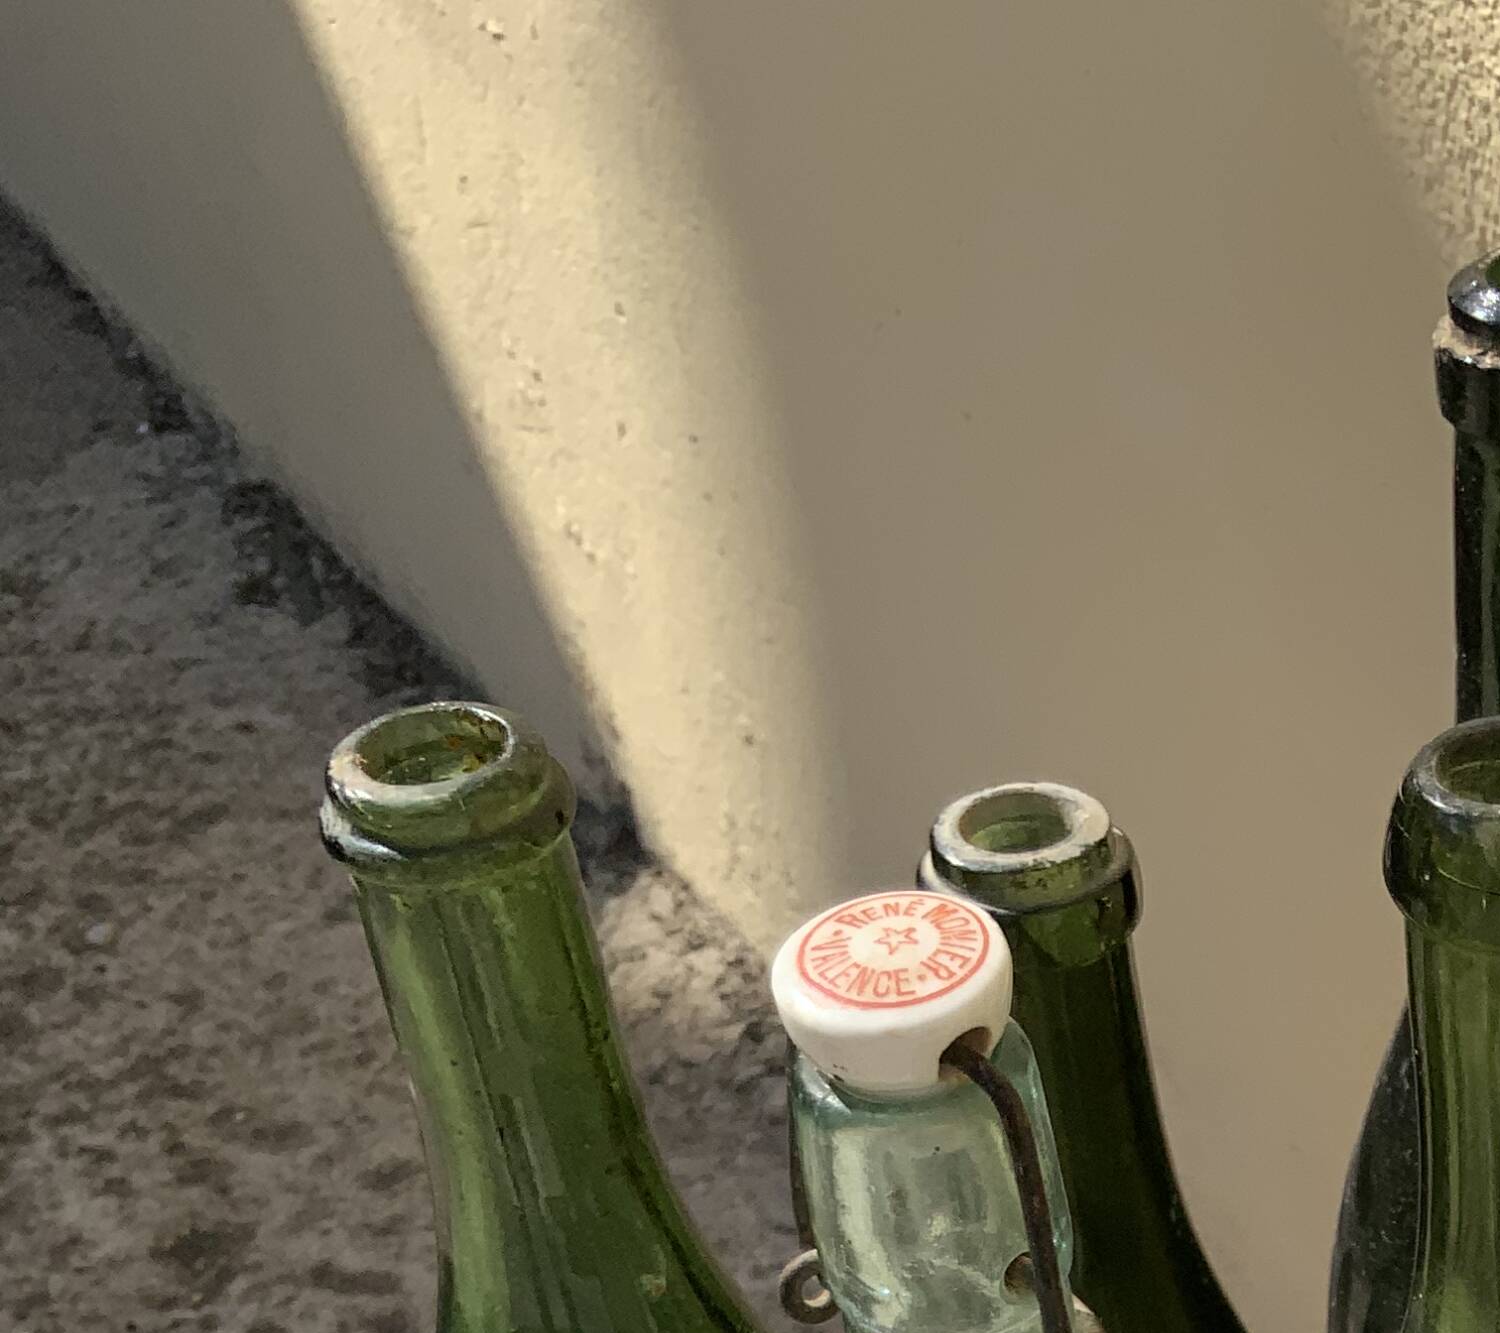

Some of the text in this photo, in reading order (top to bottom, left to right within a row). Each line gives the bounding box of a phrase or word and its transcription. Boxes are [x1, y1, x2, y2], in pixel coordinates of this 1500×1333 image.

[810, 936, 917, 998] VALENCE
[834, 898, 978, 981] RENÉ MONIER
